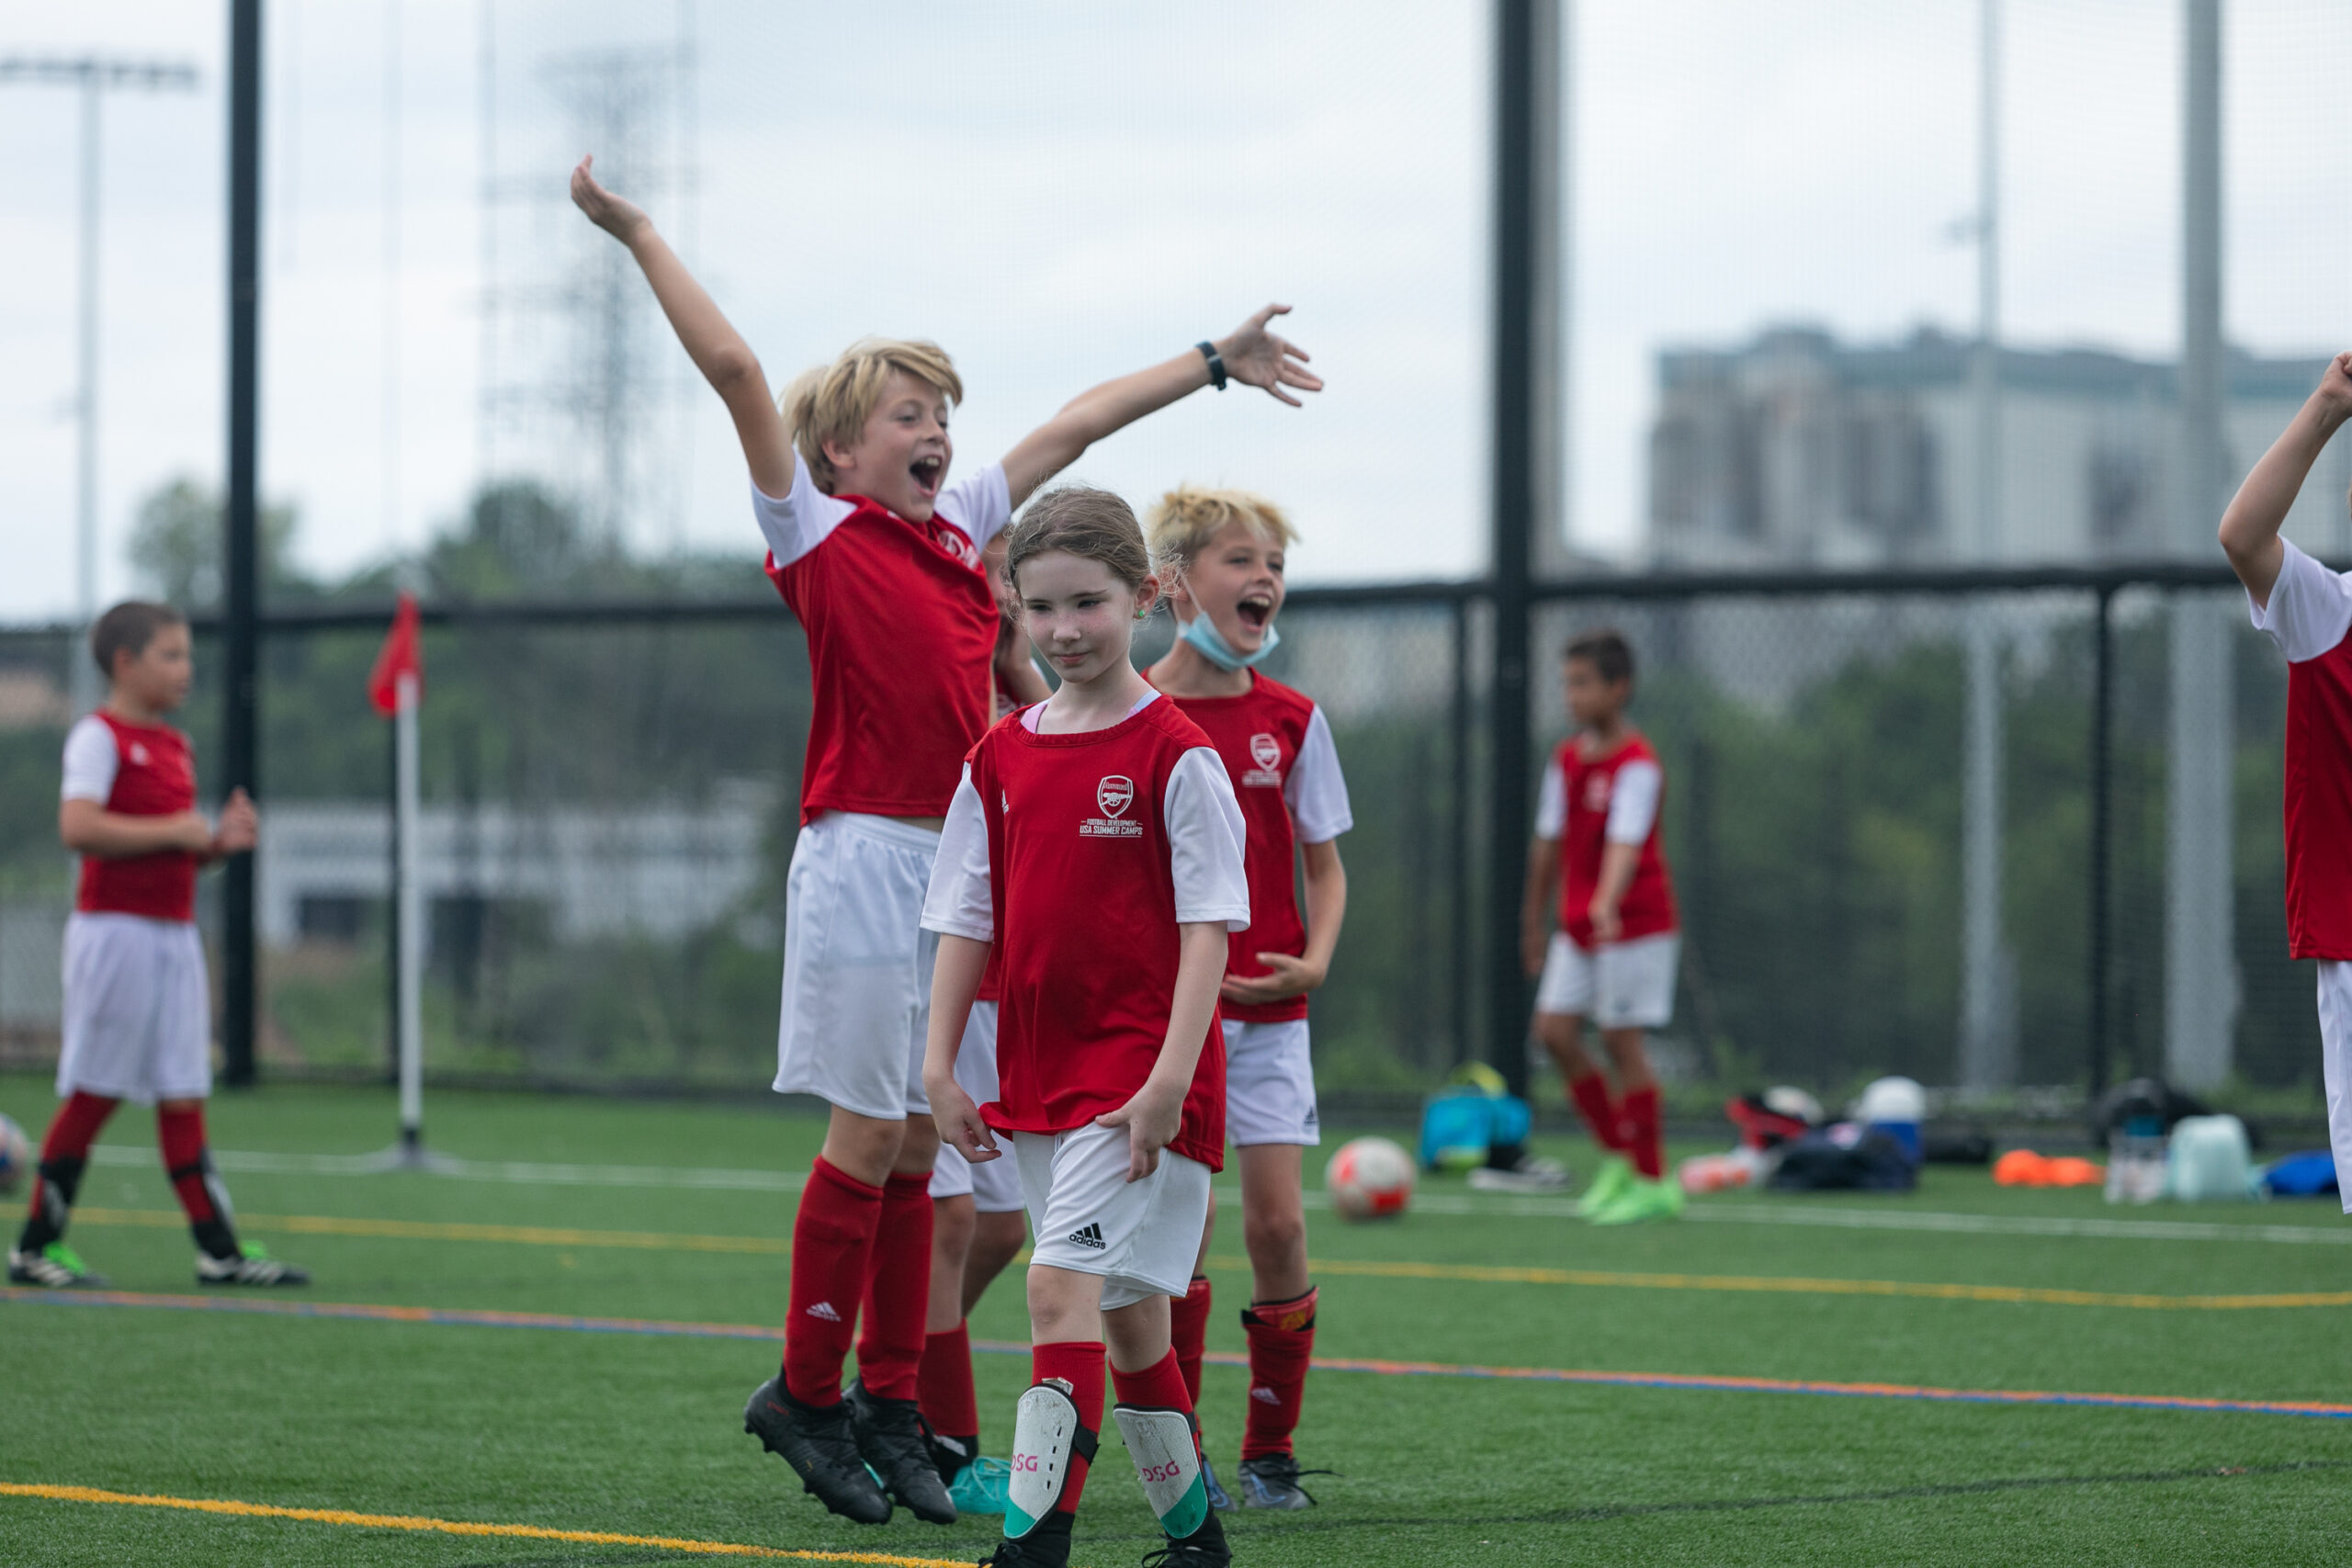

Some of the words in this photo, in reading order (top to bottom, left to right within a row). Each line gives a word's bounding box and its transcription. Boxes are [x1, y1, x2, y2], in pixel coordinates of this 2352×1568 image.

[1080, 825, 1092, 834] USA
[1093, 825, 1120, 835] SUMMER
[1121, 826, 1143, 835] CAMPS
[1069, 1234, 1106, 1250] adidas
[1141, 1460, 1181, 1483] DSG
